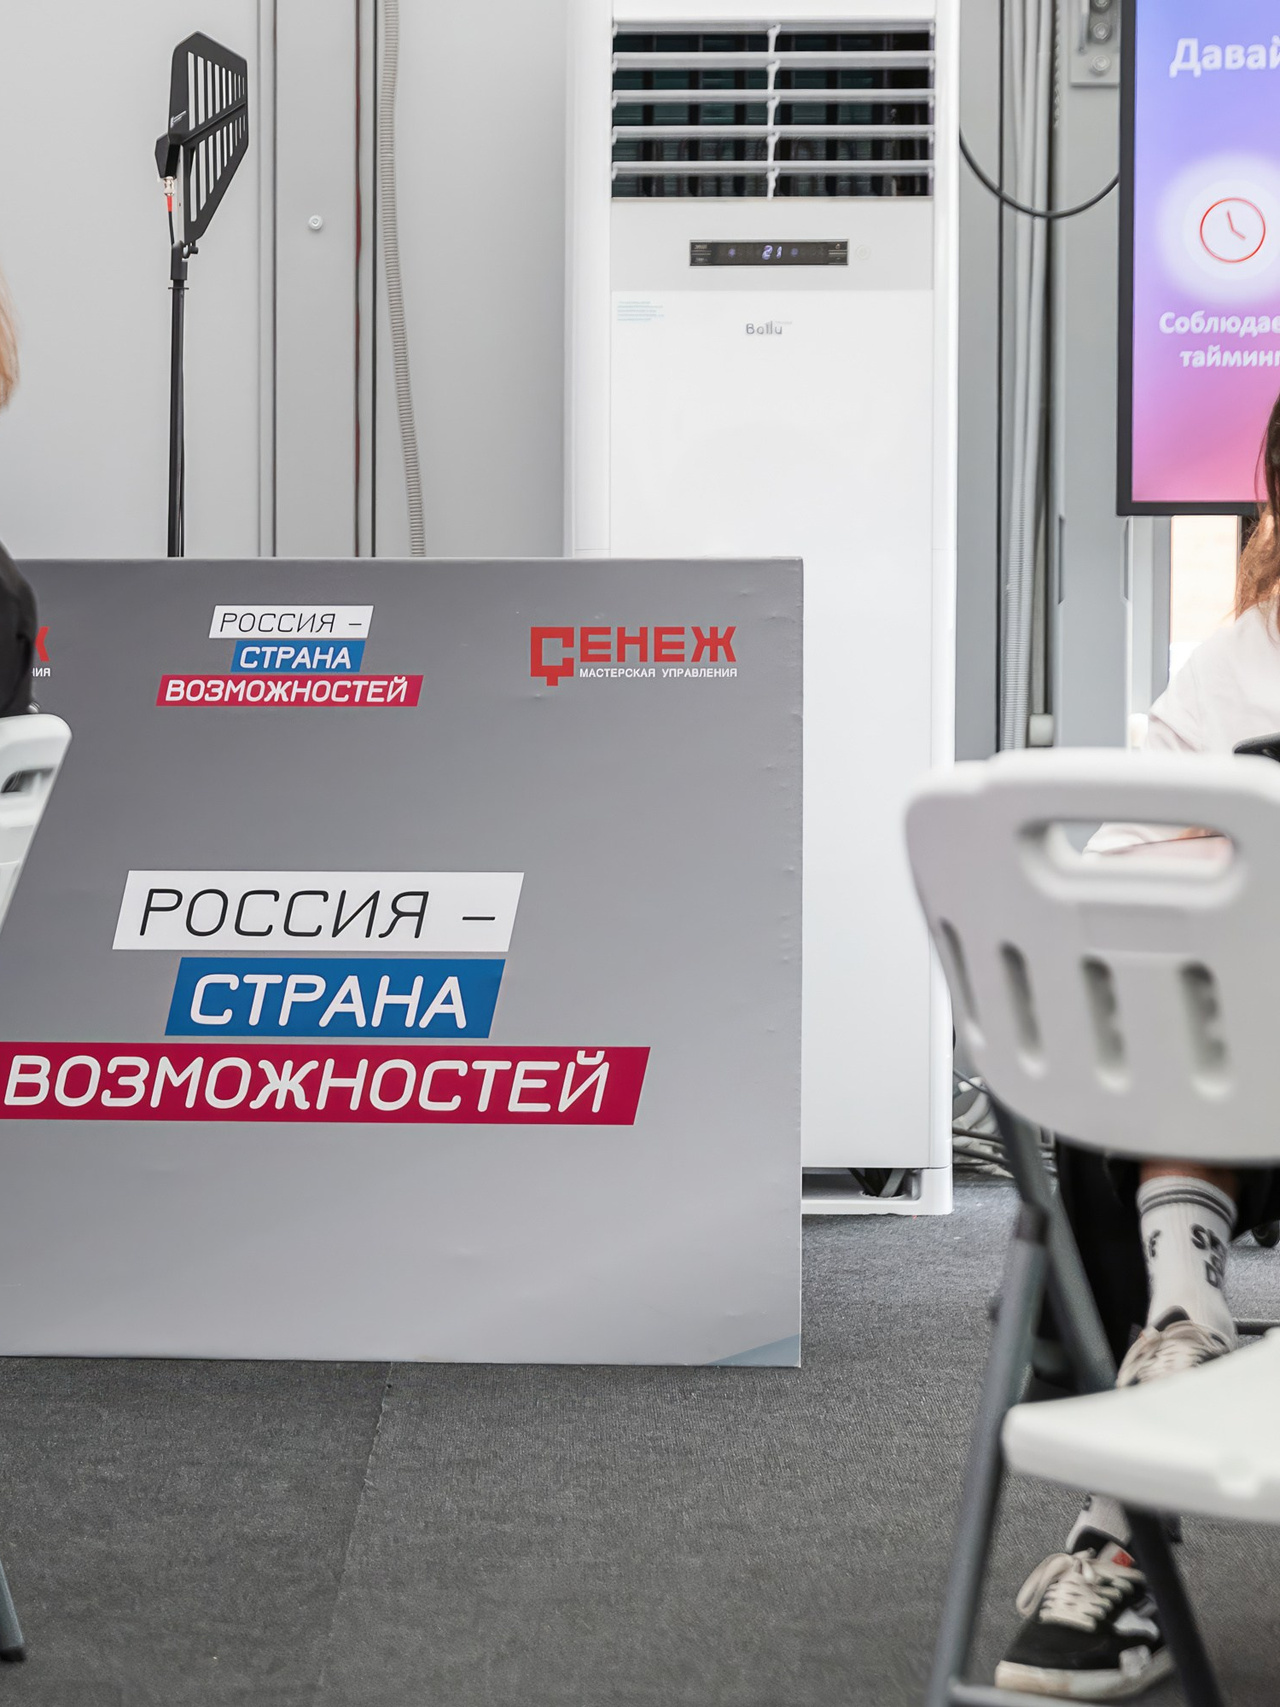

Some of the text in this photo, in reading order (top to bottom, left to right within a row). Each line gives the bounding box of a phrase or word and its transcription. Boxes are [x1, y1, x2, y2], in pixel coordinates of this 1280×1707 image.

[762, 244, 783, 260] 21
[219, 612, 336, 633] РОССИЯ
[239, 646, 352, 669] СТРАНА
[530, 626, 736, 687] СЕНЕЖ
[579, 668, 738, 678] МАСТЕРСКАЯ УПРАВЛЕНИЯ
[165, 676, 408, 703] ВОЗМОЖНОСТЕЙ
[139, 888, 430, 938] РОССИЯ
[189, 974, 467, 1029] СТРАНА
[3, 1050, 611, 1113] ВОЗМОЖНОСТЕЙ
